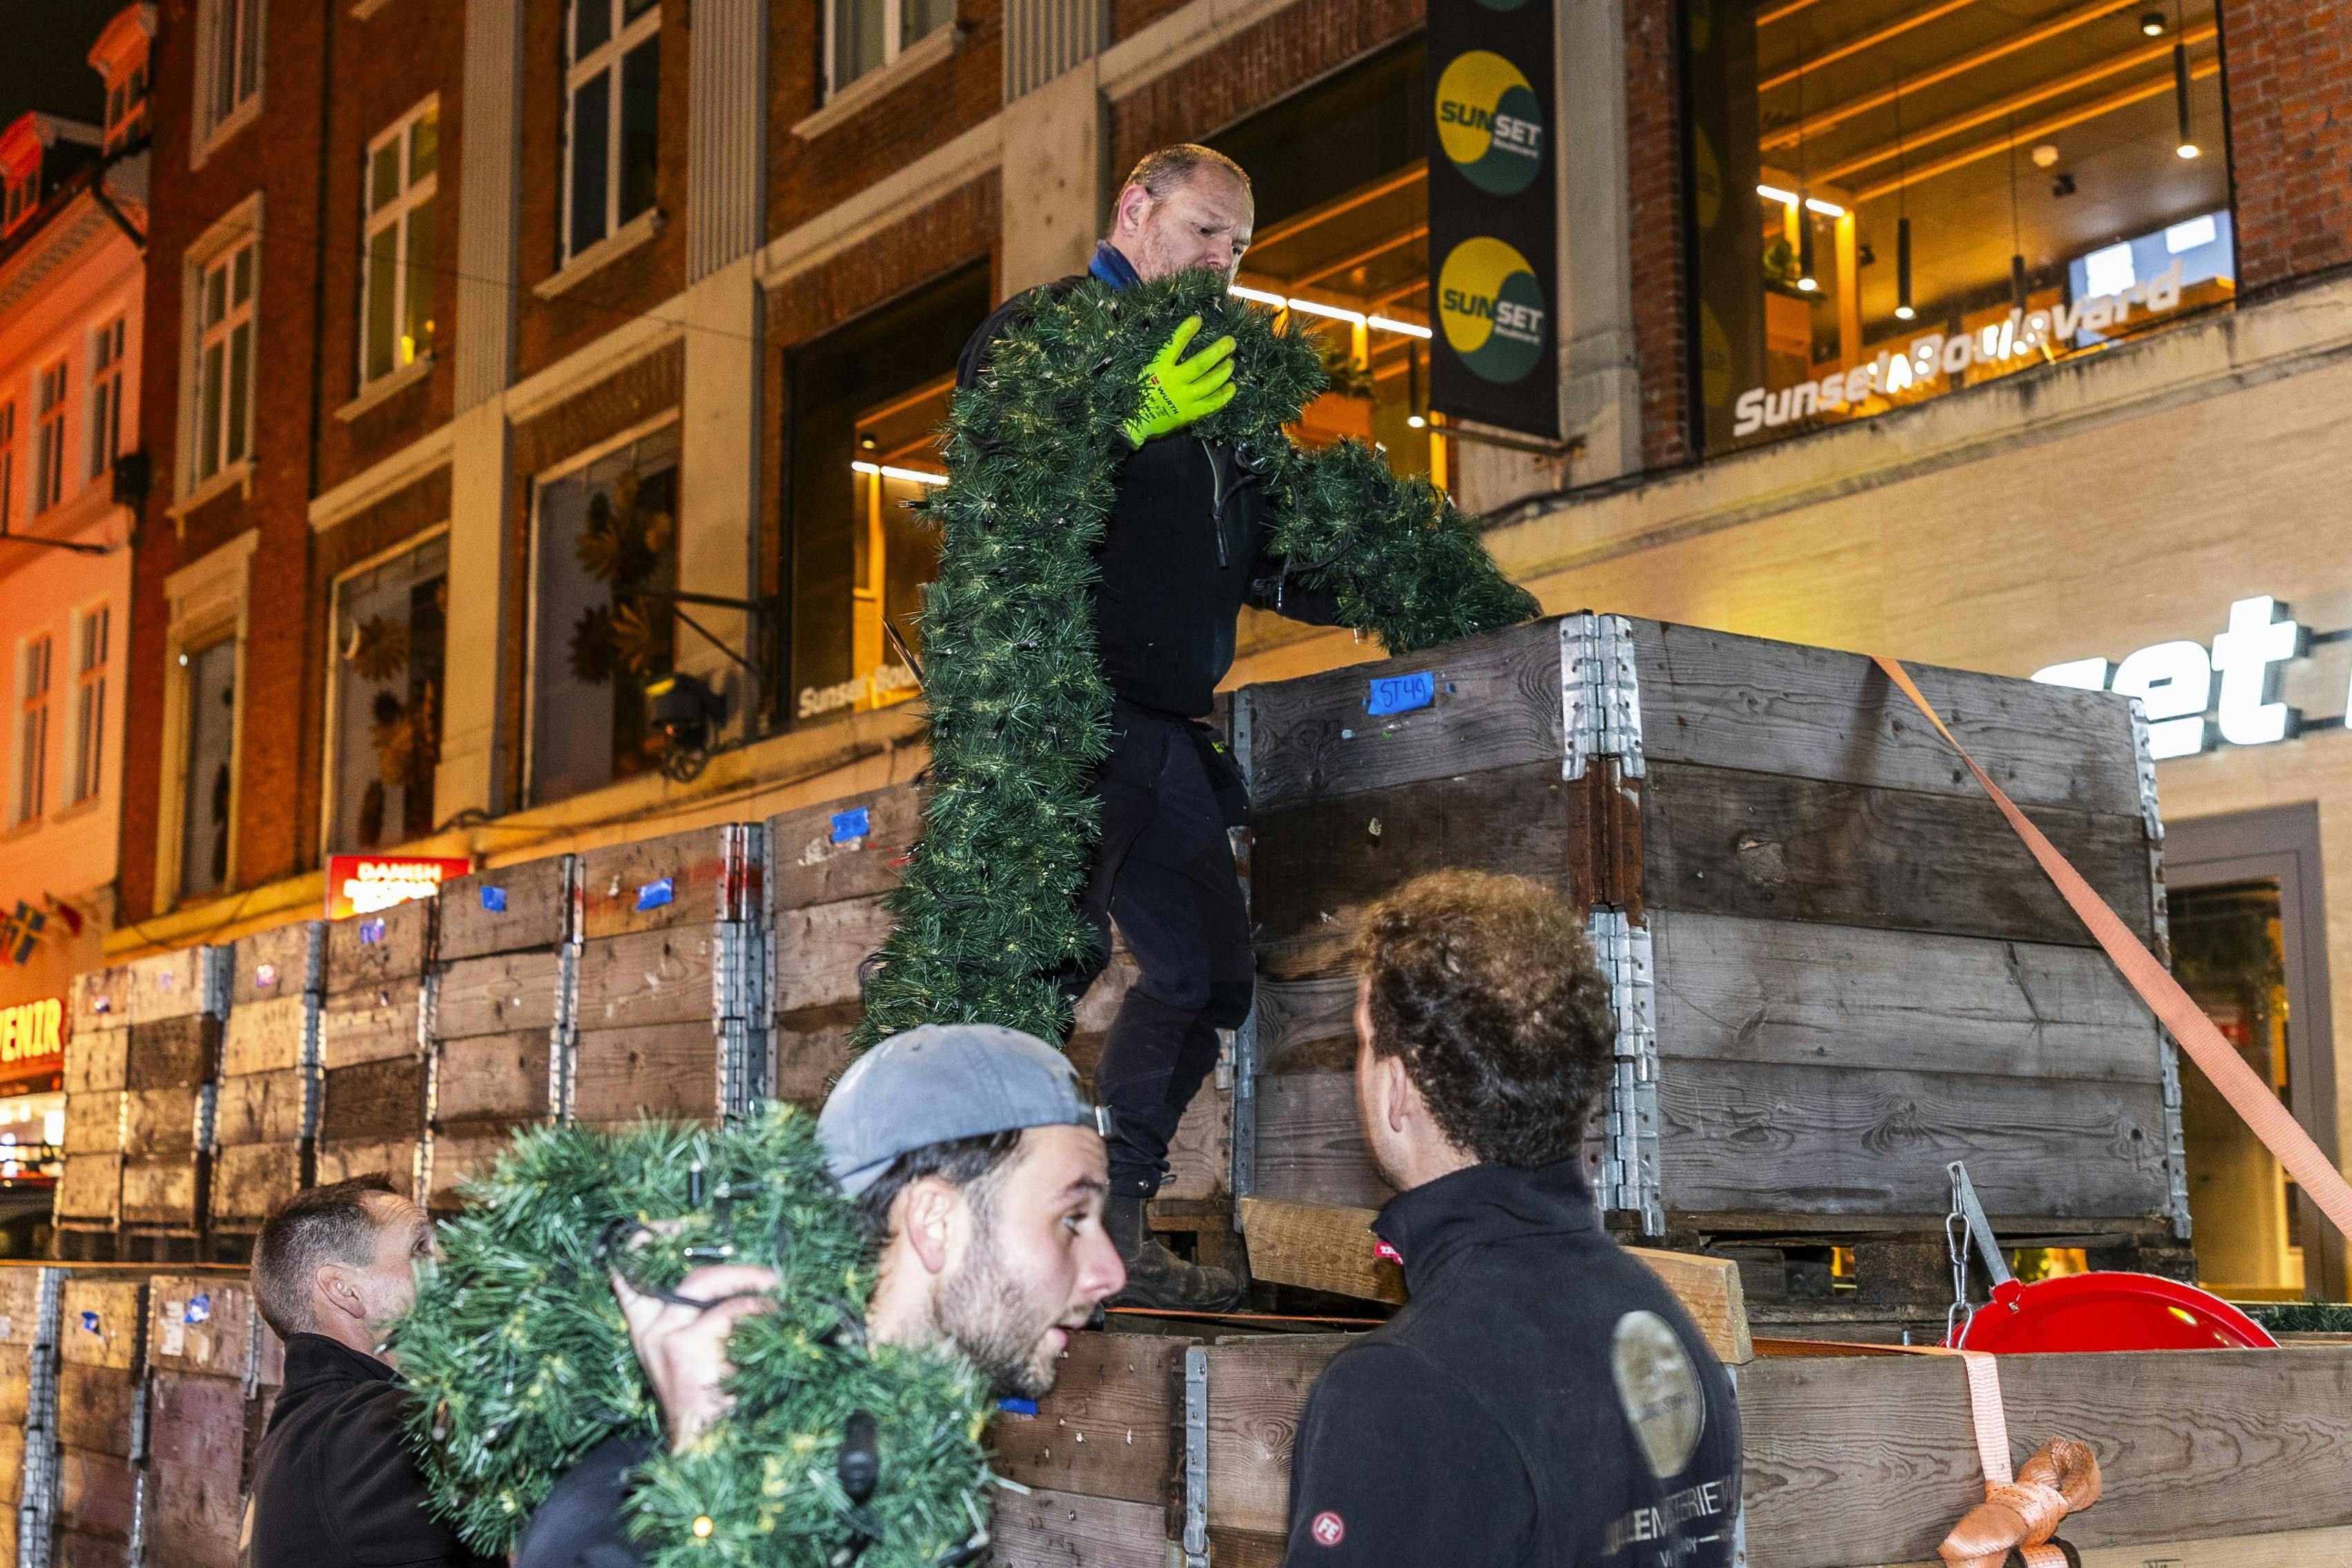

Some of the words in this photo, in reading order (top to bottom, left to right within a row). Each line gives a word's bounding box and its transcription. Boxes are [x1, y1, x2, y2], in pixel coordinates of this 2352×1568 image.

[1441, 100, 1542, 146] SUNSET
[1443, 288, 1544, 333] SUNSET
[1733, 349, 1890, 437] Sunset
[1908, 258, 2184, 382] Boulevard
[1380, 678, 1426, 707] ST49
[2030, 595, 2297, 760] et
